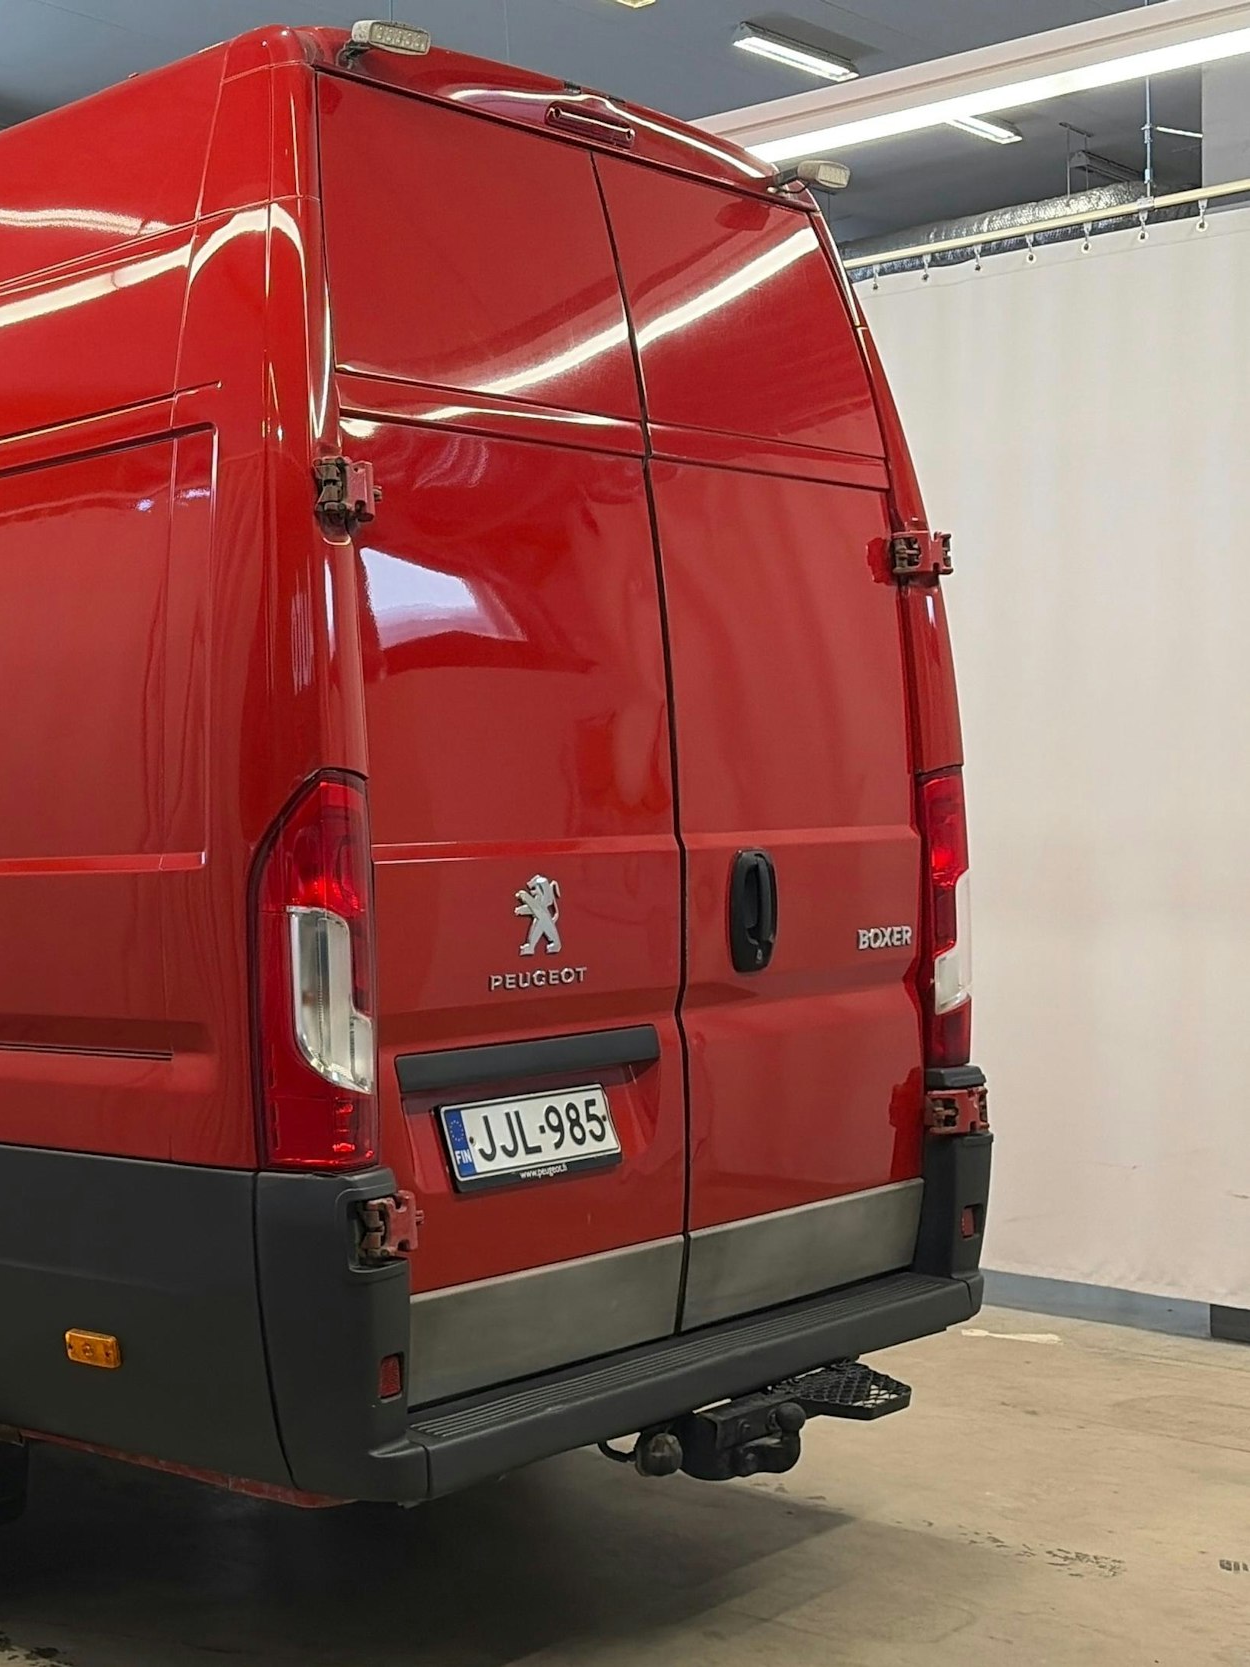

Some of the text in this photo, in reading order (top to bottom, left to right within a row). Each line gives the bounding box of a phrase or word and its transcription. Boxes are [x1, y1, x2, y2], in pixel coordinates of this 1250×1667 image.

[857, 925, 912, 950] BOXER
[489, 966, 587, 992] PEUGEOT
[479, 1098, 606, 1162] JJL-985
[455, 1149, 472, 1164] FIN
[520, 1162, 568, 1179] www.peugeot.fi
